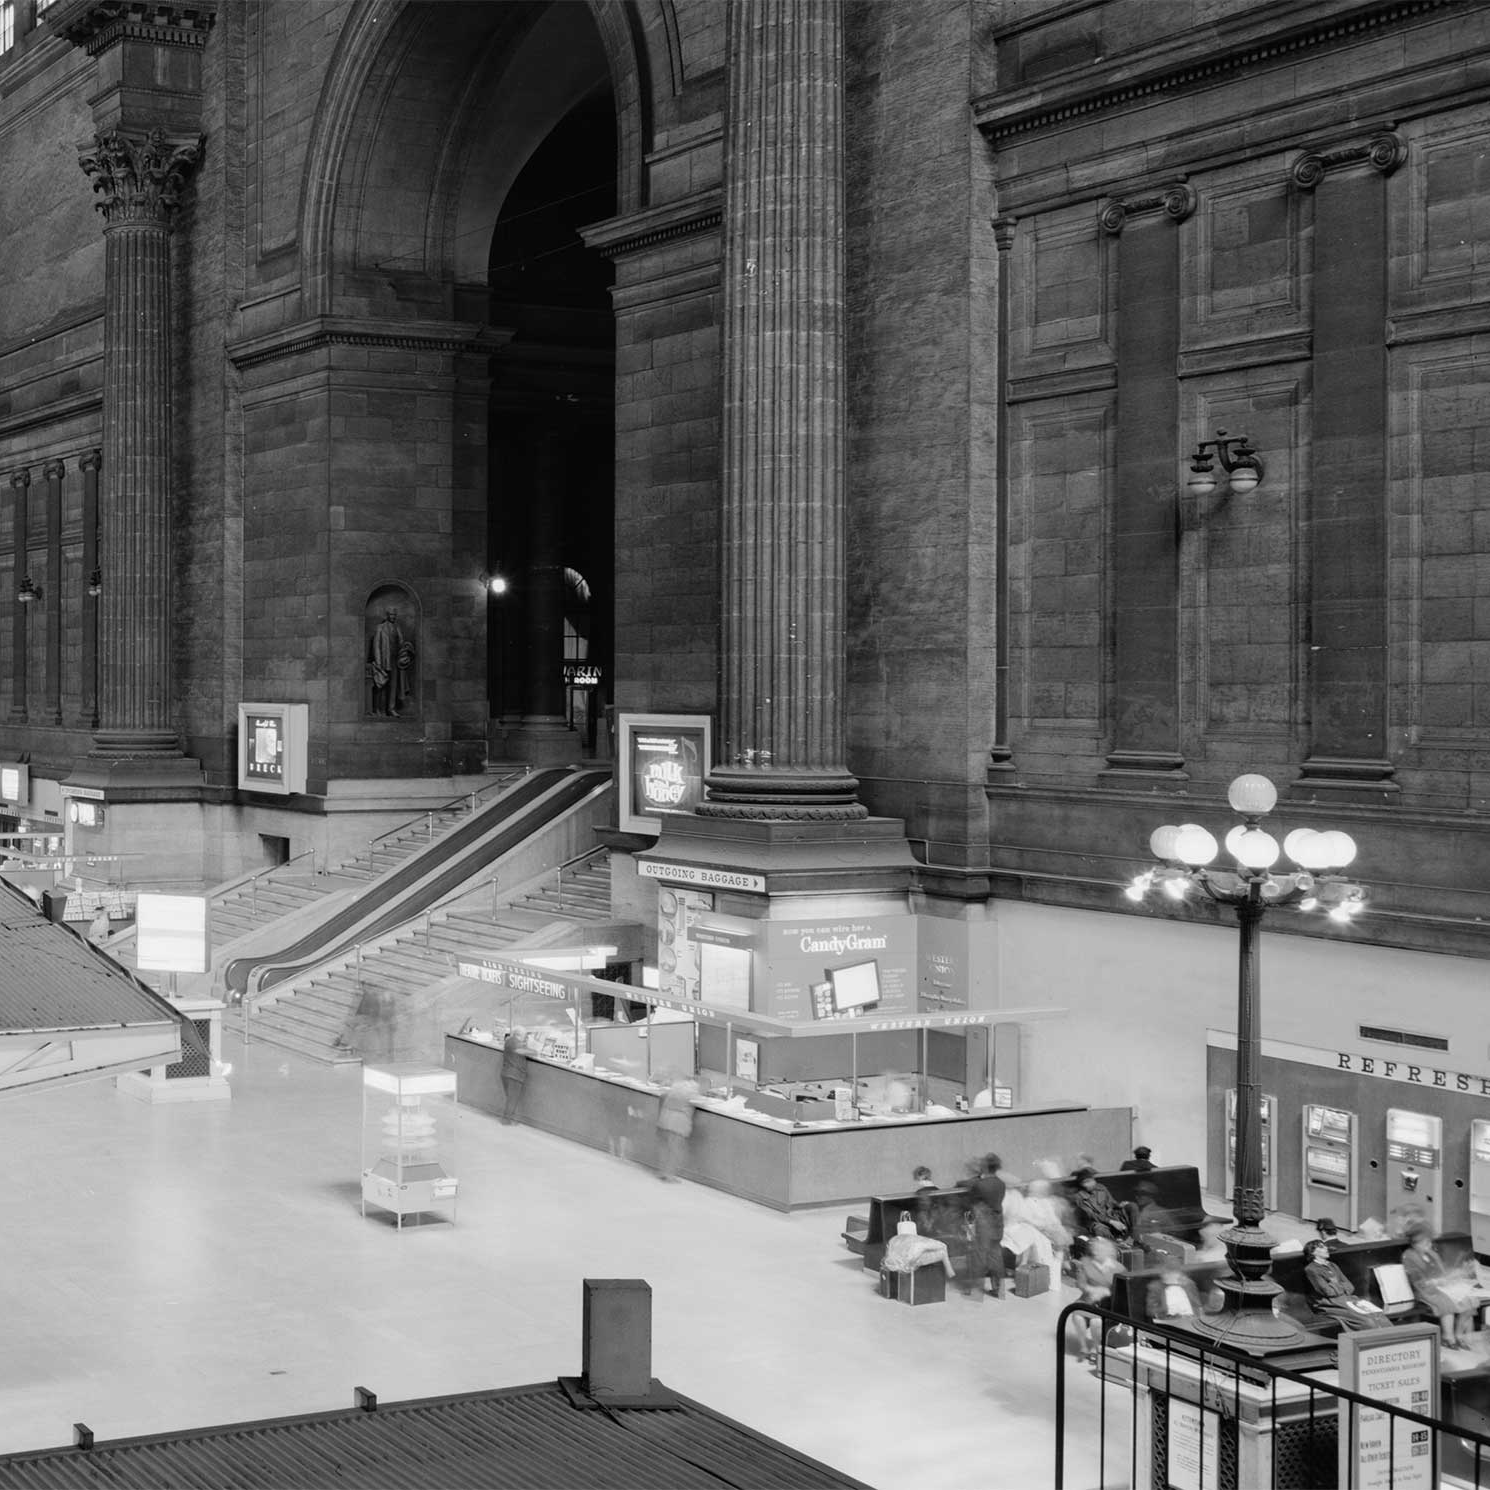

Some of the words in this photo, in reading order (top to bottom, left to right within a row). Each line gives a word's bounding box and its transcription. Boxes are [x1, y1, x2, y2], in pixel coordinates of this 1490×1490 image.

[250, 763, 281, 773] BRECK
[646, 865, 695, 880] OUTGOING
[701, 872, 749, 887] BAGGAGE
[800, 934, 886, 955] CandyGram
[509, 974, 566, 999] SIGHTSEEING
[944, 1016, 985, 1024] UNION
[1367, 1350, 1420, 1366] DIRECTORY
[1368, 1380, 1395, 1391] TICKET
[1398, 1377, 1420, 1387] SALES
